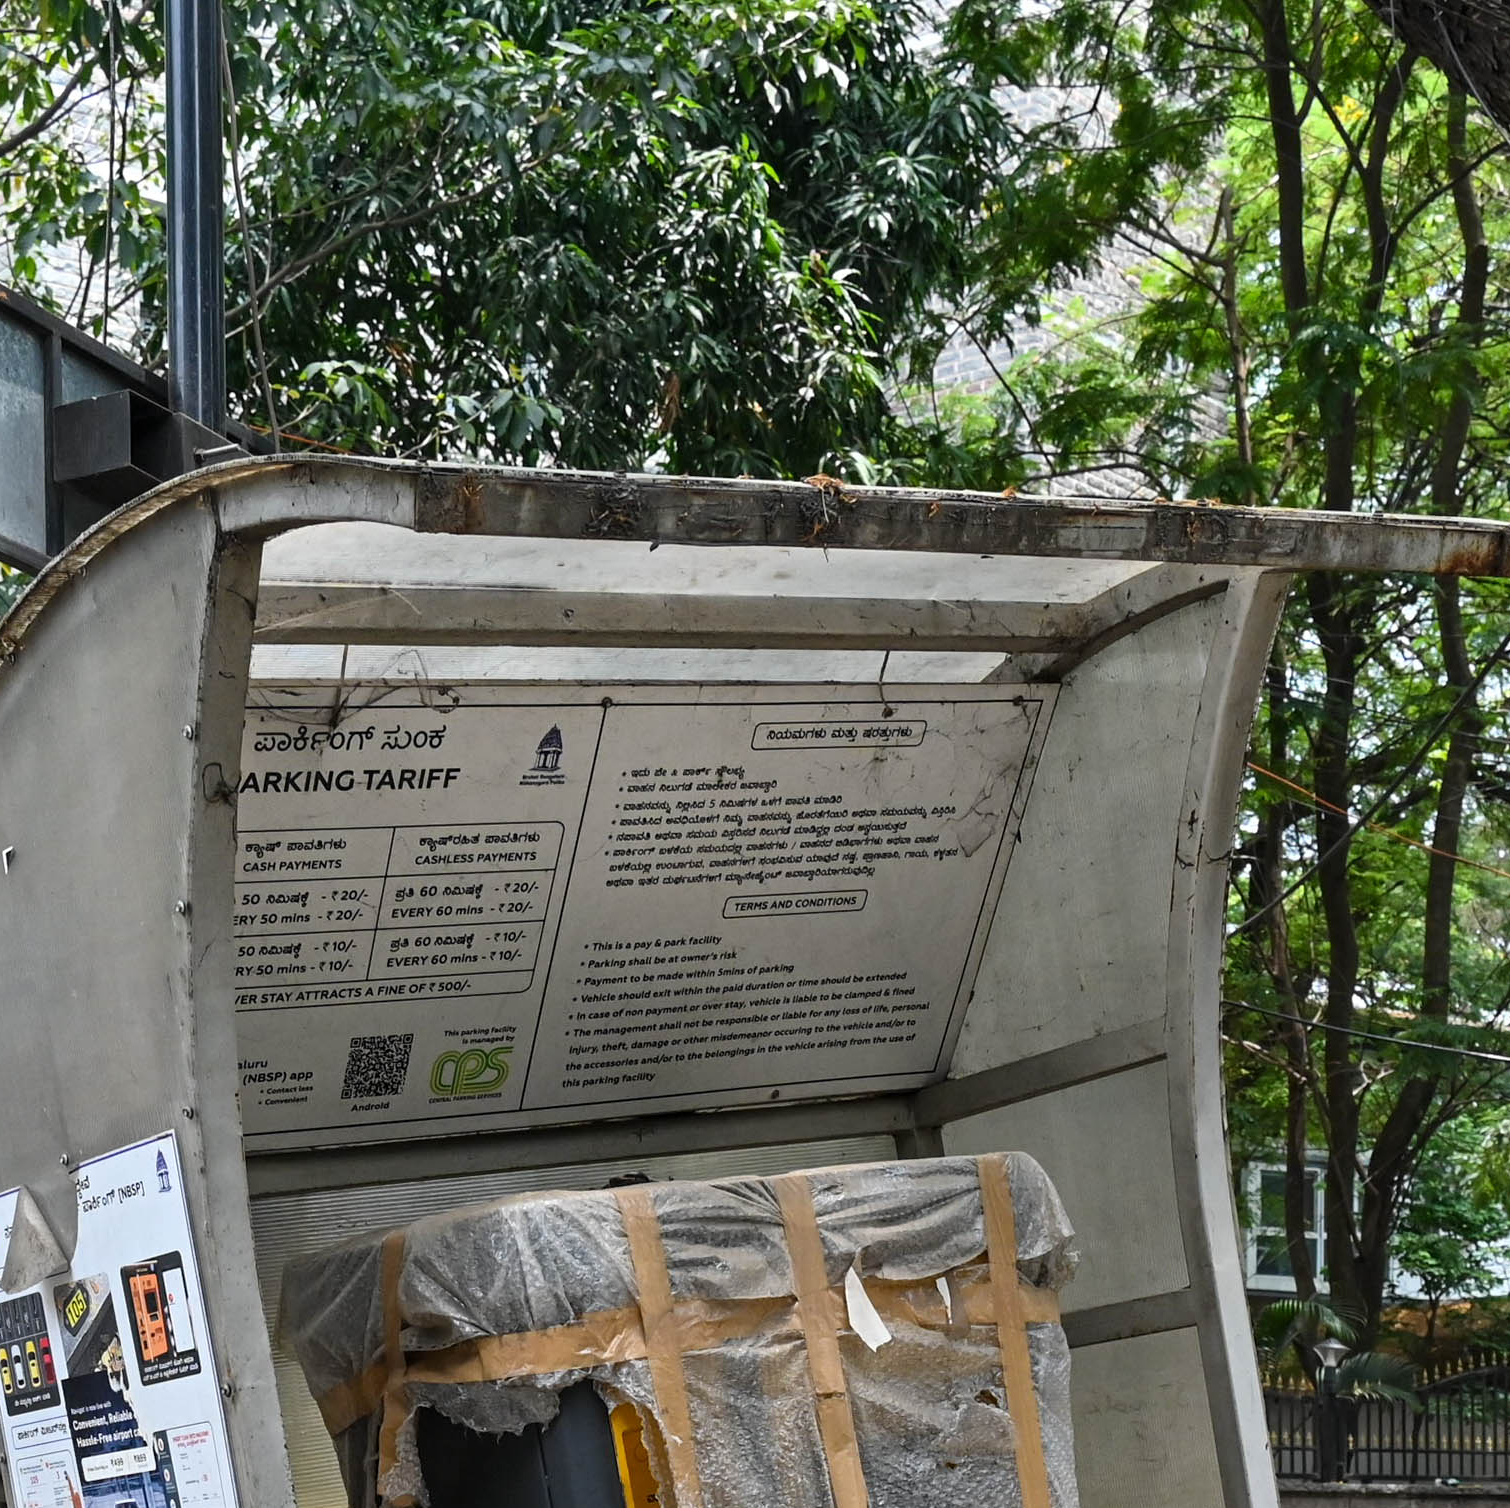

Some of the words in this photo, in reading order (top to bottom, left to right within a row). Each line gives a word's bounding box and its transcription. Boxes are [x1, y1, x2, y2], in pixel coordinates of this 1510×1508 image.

[253, 724, 376, 751] ಪಾರ್ಕಿಂಗ್
[380, 724, 447, 750] ಸುಂಕ
[238, 769, 355, 794] ARKING
[363, 767, 461, 791] TARIFF
[414, 853, 475, 866] CASHLESS
[476, 851, 537, 863] PAYMENTS
[242, 861, 277, 873] CASH
[278, 859, 342, 871] PAYMENTS
[419, 885, 438, 898] 60
[241, 893, 261, 906] 50
[734, 901, 769, 912] TERMS
[769, 899, 793, 910] AND
[794, 896, 858, 908] CONDITIONS
[259, 913, 278, 925] 50
[280, 912, 311, 924] mins
[391, 906, 434, 919] EVERY
[435, 905, 453, 917] 60
[455, 905, 484, 916] mins
[414, 936, 432, 947] 60
[237, 945, 256, 957] 50
[386, 955, 429, 968] EVERY
[430, 953, 448, 965] 60
[450, 953, 479, 964] mins
[256, 964, 274, 976] 50
[276, 963, 307, 975] mins
[260, 991, 294, 1004] STAY
[295, 987, 363, 1002] ATTRACTS
[364, 987, 374, 997] A
[377, 984, 407, 996] FINE
[408, 983, 427, 994] OF
[242, 1071, 287, 1087] (NBSP)
[289, 1071, 314, 1082] app
[350, 1101, 390, 1112] Android
[117, 1181, 145, 1204] [NBSP]
